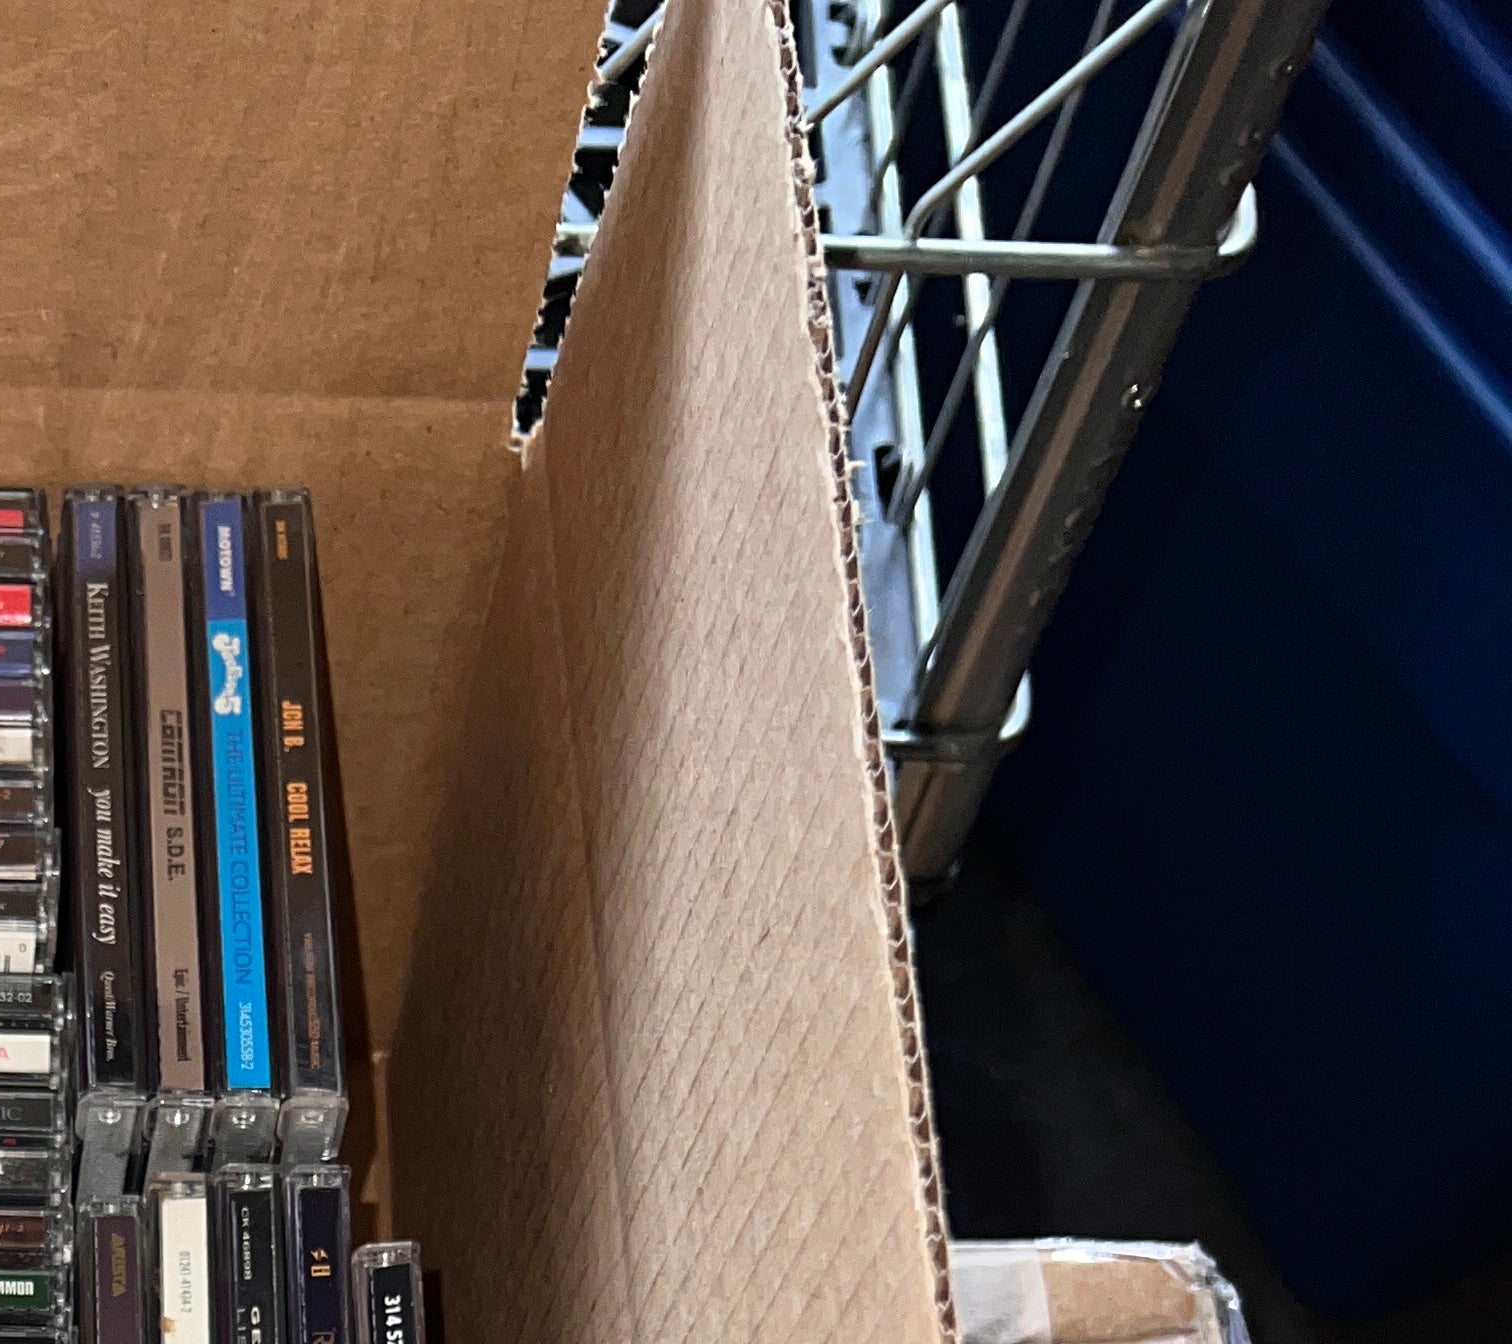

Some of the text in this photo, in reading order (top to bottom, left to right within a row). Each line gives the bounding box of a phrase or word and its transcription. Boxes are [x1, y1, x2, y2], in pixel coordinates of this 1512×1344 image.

[217, 526, 233, 591] MOTOWN
[167, 826, 185, 881] S.D.E.
[286, 782, 312, 875] COOL RELAX
[92, 829, 121, 945] make easy
[230, 862, 252, 984] COLLECTION
